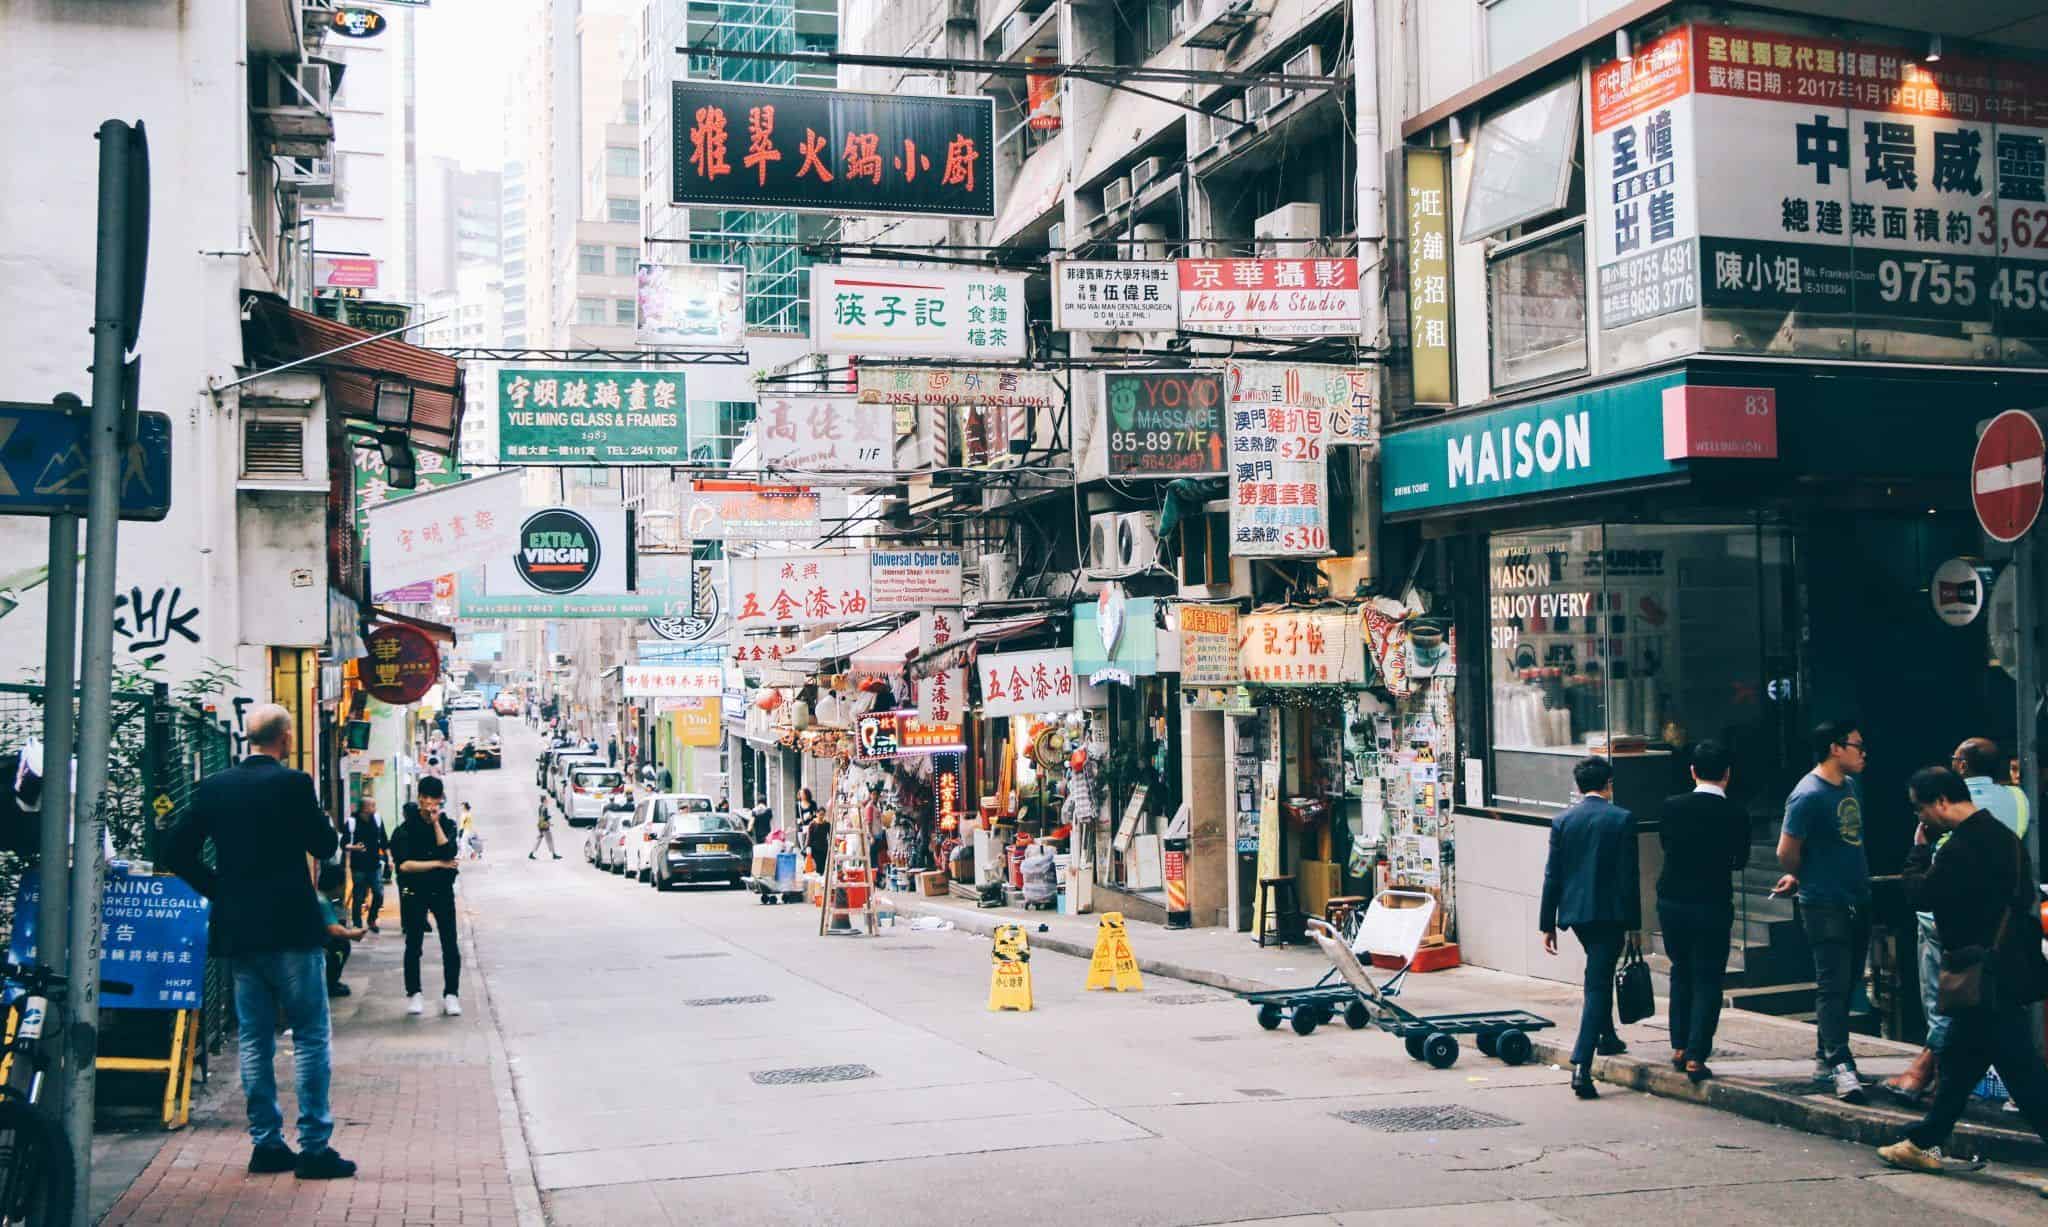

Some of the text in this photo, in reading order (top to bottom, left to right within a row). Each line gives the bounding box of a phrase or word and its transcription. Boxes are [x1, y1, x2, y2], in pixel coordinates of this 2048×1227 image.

[1615, 189, 1674, 256] 出售
[1191, 261, 1345, 288] 京華攝影
[1714, 250, 1802, 294] 陳小姐
[1879, 259, 1976, 305] 9755
[834, 292, 948, 327] 筷子記
[1288, 291, 1347, 313] Studio
[885, 392, 919, 406] 2854
[1143, 379, 1219, 407] YOYO
[1744, 395, 1769, 416] 83
[508, 412, 678, 427] YUE MING GLASS & FRAMES
[1137, 409, 1219, 429] MASSAGE
[1111, 431, 1207, 452] 85-89 7/F
[1281, 436, 1321, 461] $26
[1446, 411, 1592, 489] MAISON
[1235, 460, 1273, 482] 澳門
[529, 531, 585, 548] EXTRA
[1284, 527, 1325, 550] $30
[523, 546, 589, 564] VIRGIN
[872, 551, 960, 567] Universal Cyber Café
[1491, 563, 1549, 588] MAISON
[737, 586, 867, 621] 五金漆油
[1491, 592, 1591, 619] ENJOY EVERY
[1491, 625, 1518, 649] SIP!
[987, 662, 1073, 702] 五金漆油
[105, 908, 182, 919] OWED AWAY
[165, 979, 193, 988] HKPF
